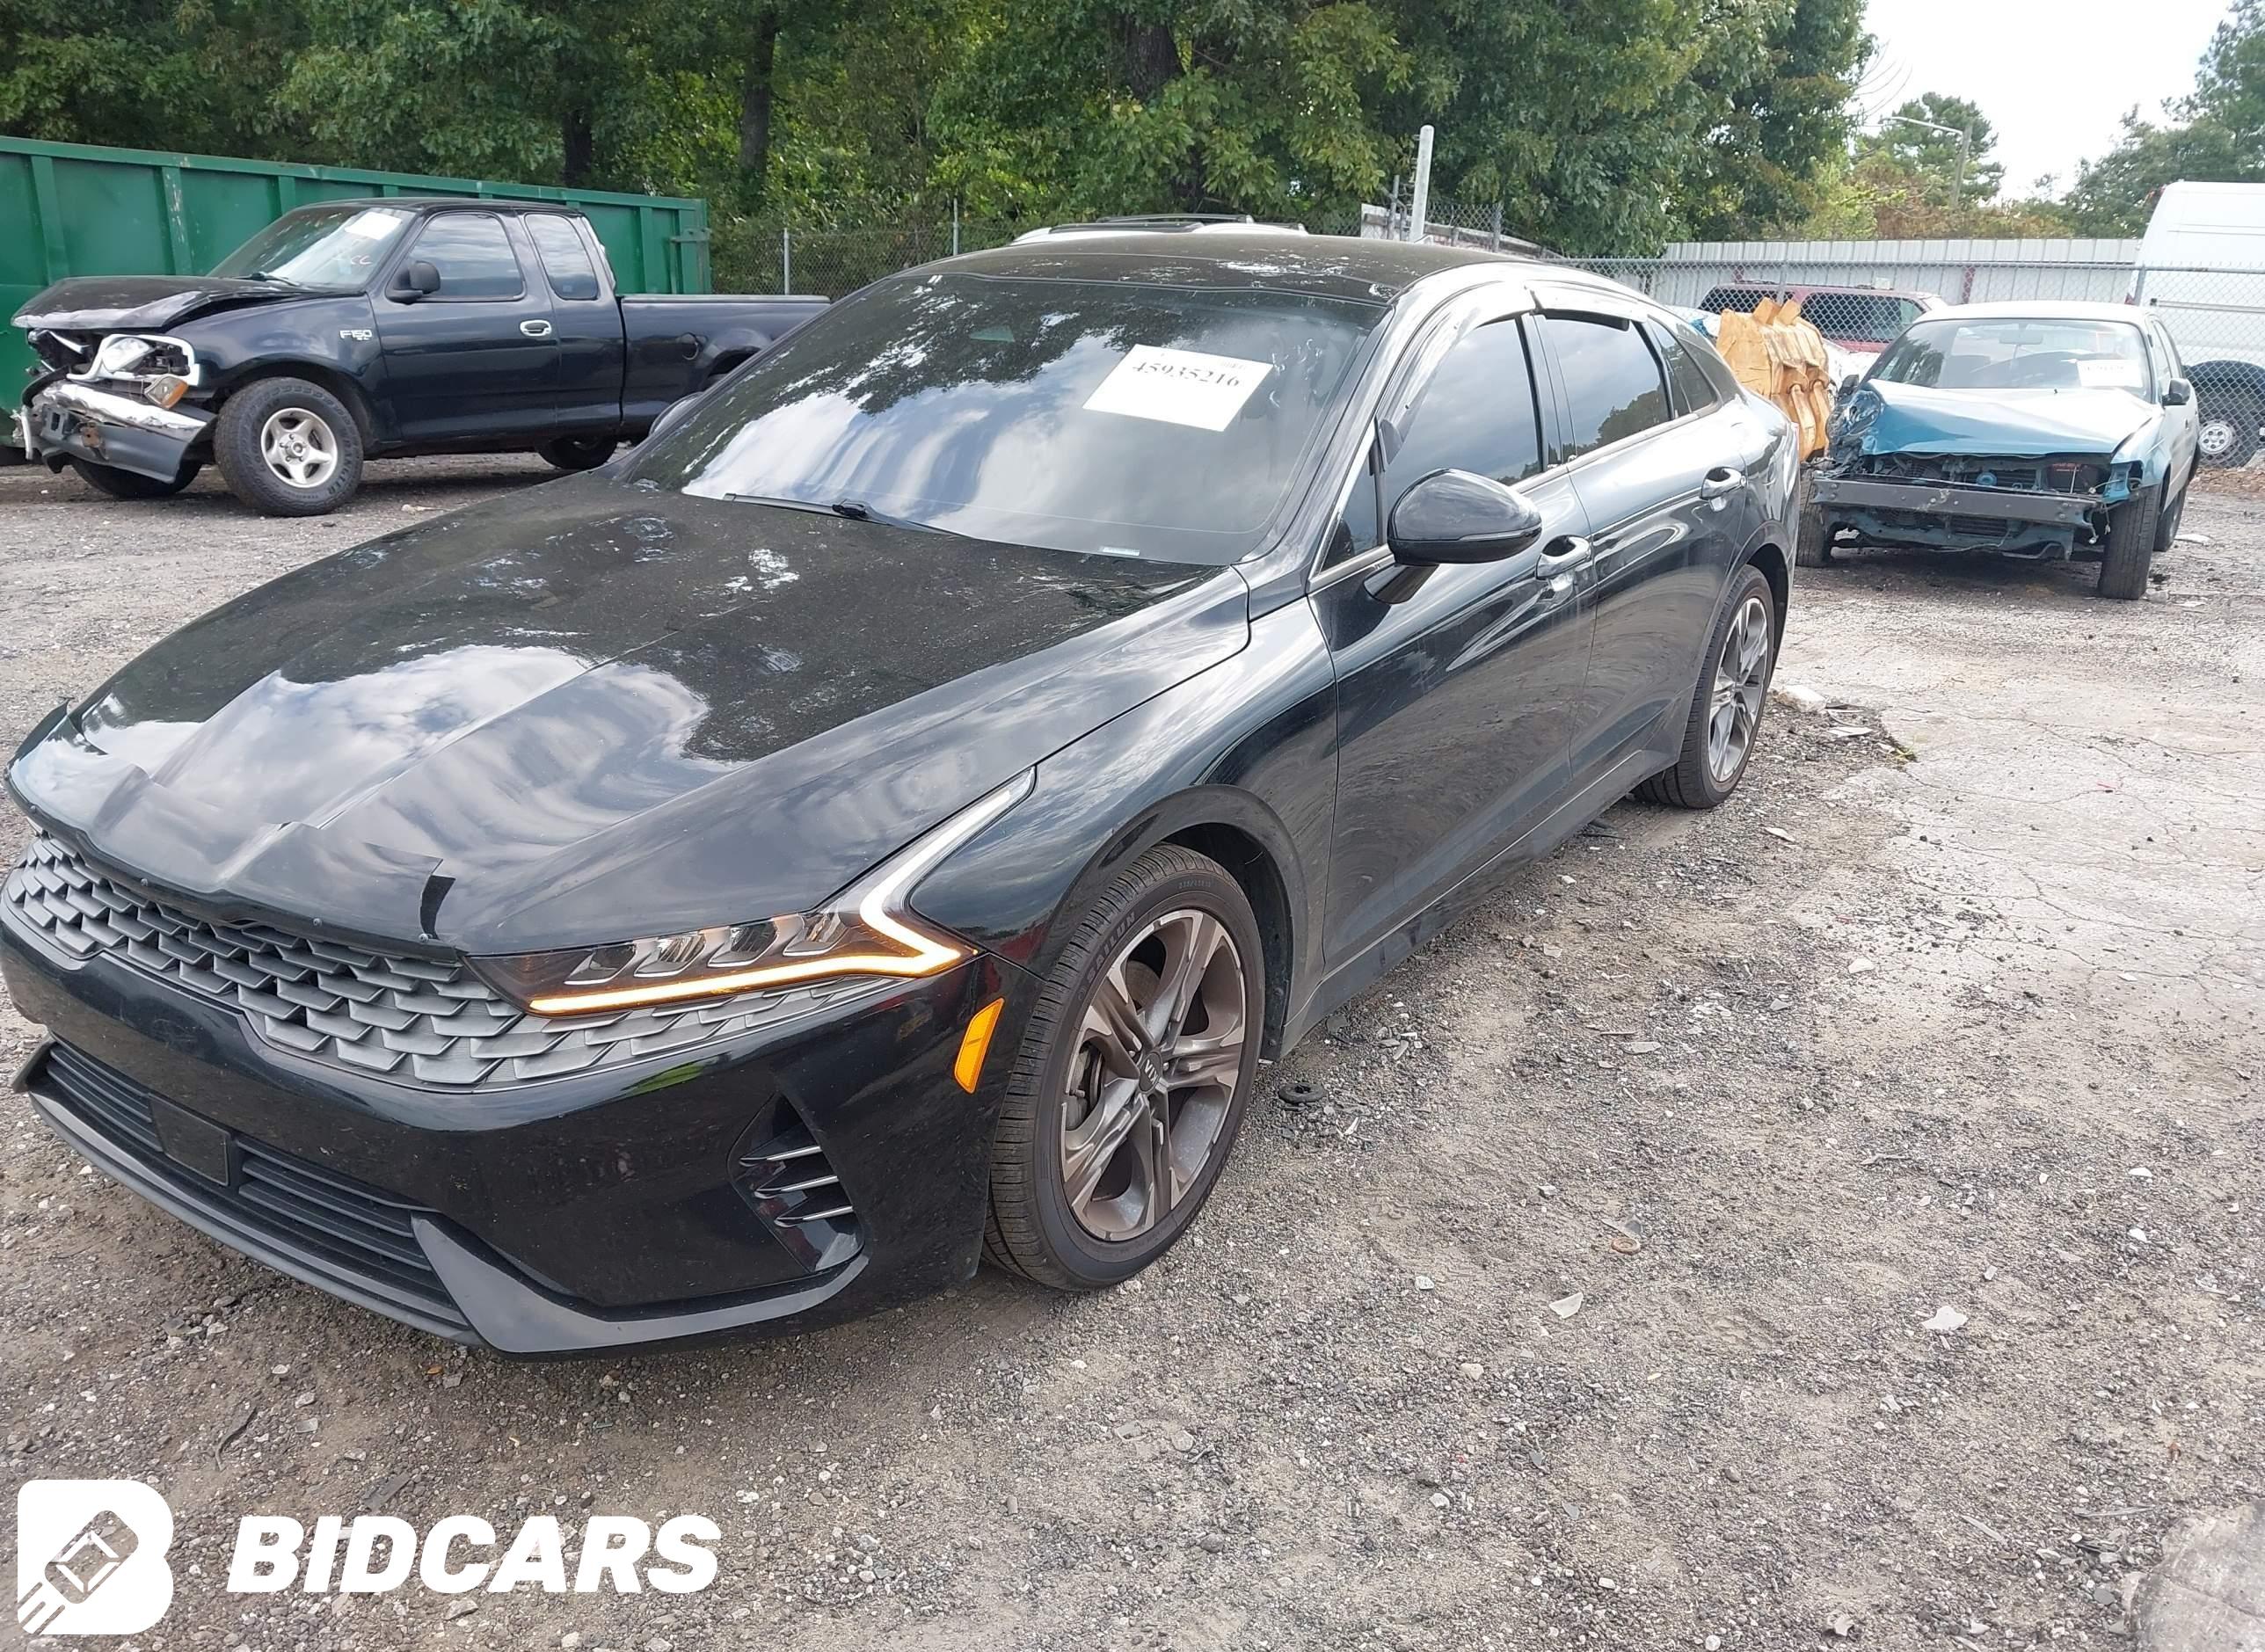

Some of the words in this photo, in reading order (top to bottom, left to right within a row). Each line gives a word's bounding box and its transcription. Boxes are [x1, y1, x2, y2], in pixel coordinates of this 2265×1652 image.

[339, 329, 373, 339] F150
[1132, 361, 1240, 387] 45935216
[1087, 911, 1135, 984] SAILUN
[1144, 1059, 1159, 1085] KIA
